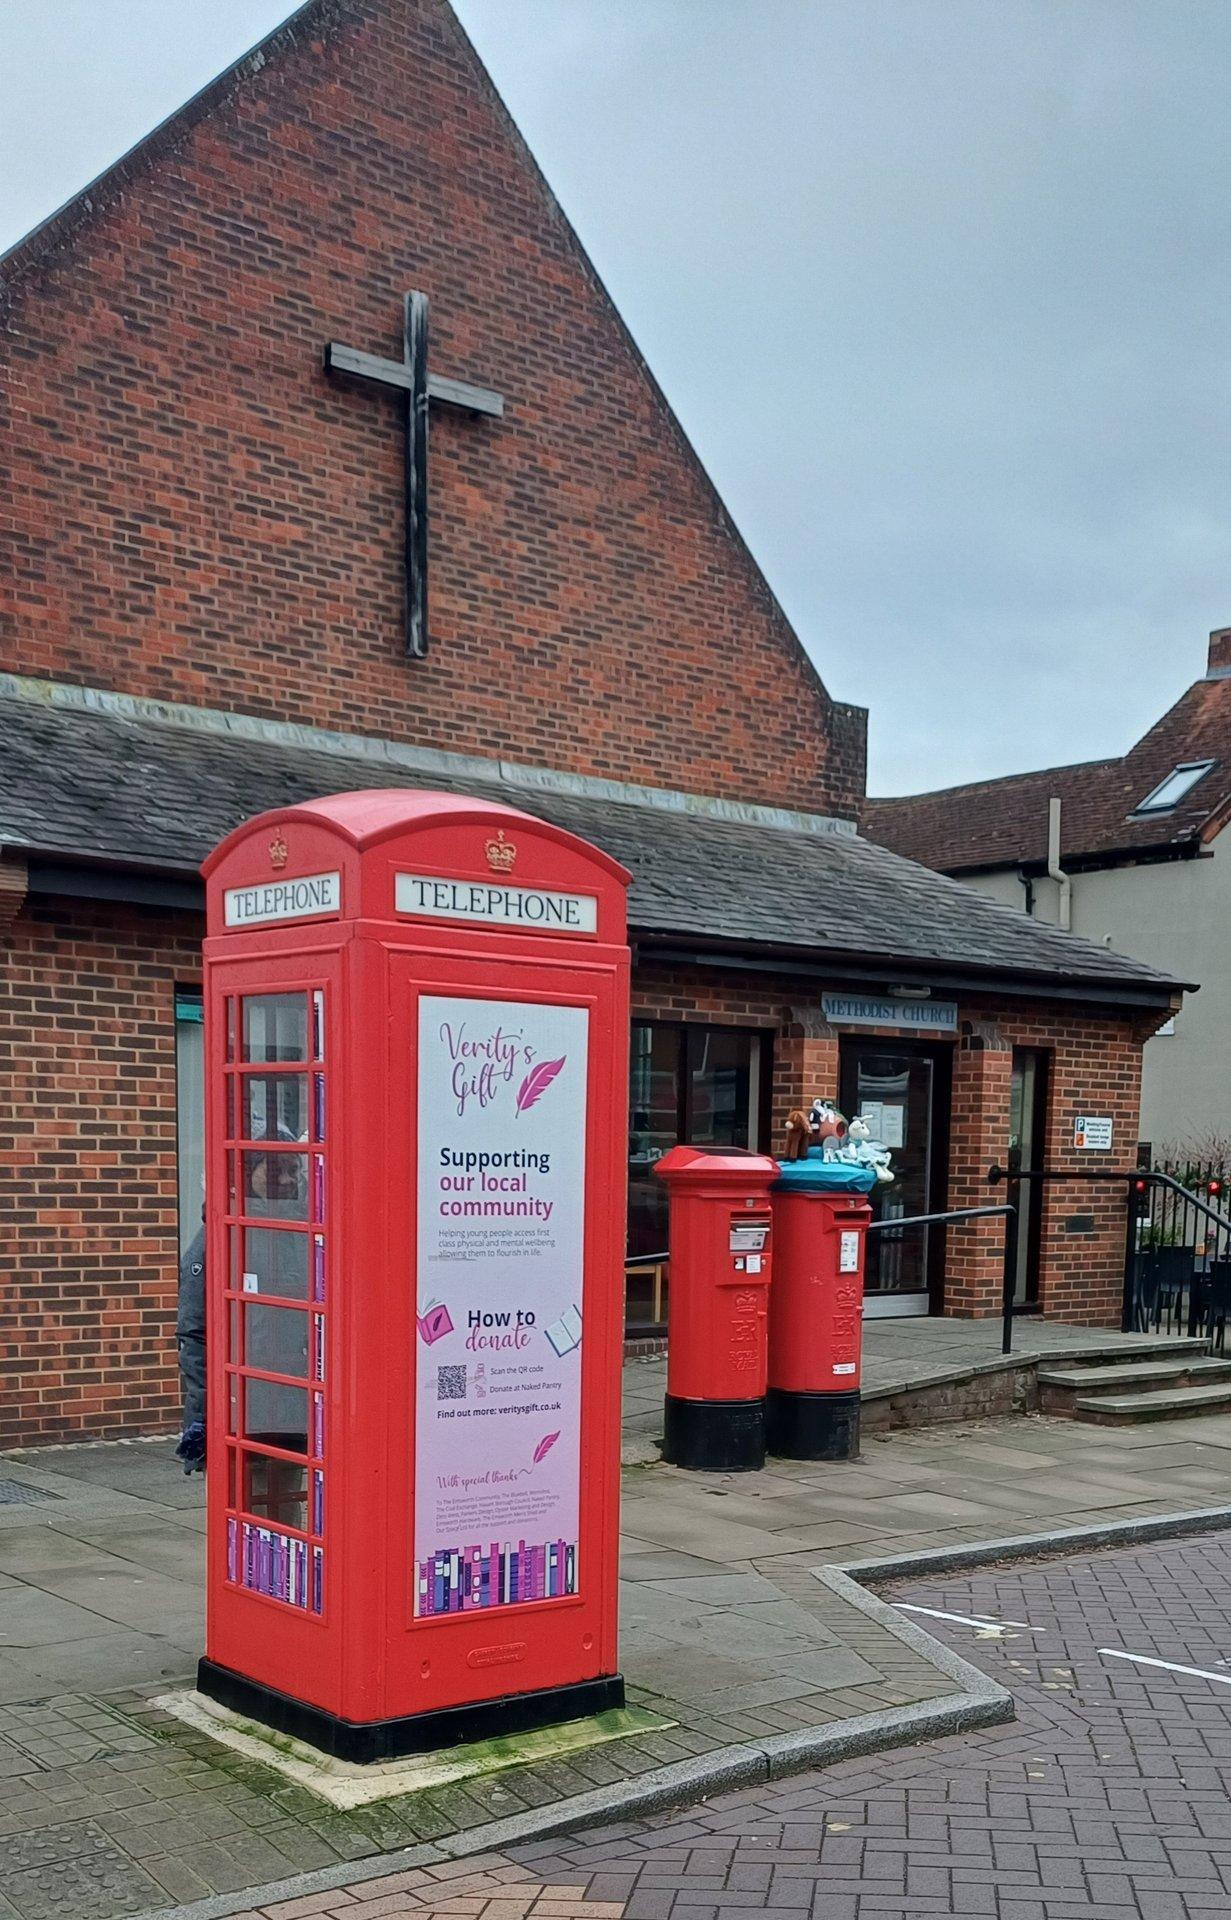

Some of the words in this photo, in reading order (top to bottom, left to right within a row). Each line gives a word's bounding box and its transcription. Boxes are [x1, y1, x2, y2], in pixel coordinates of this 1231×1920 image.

[234, 879, 332, 918] TELEPHONE
[412, 880, 581, 924] TELEPHONE
[824, 999, 897, 1019] METHODIST
[902, 1005, 955, 1024] CHURCH
[440, 1022, 537, 1081] Verity's
[452, 1062, 513, 1116] Gift
[440, 1147, 550, 1173] Supporting
[440, 1176, 475, 1191] our
[481, 1172, 527, 1192] local
[440, 1197, 553, 1221] community
[438, 1229, 466, 1238] Helping
[466, 1231, 488, 1239] young
[489, 1229, 513, 1238] people
[514, 1229, 536, 1237] access
[536, 1228, 550, 1237] first
[438, 1240, 456, 1248] class
[457, 1239, 485, 1250] physical
[486, 1239, 499, 1247] and
[500, 1238, 524, 1247] mental
[525, 1238, 556, 1248] wellbeing
[467, 1249, 487, 1257] them
[488, 1249, 495, 1257] to
[496, 1248, 521, 1257] flourish
[522, 1248, 530, 1257] in
[468, 1310, 511, 1328] How
[516, 1309, 536, 1326] to
[466, 1322, 537, 1351] donate
[490, 1368, 506, 1376] Scan
[518, 1366, 528, 1374] QR
[529, 1365, 544, 1373] code
[490, 1385, 512, 1393] Donate
[521, 1382, 541, 1392] Naked
[542, 1381, 562, 1392] Pantry
[437, 1409, 455, 1419] Find
[457, 1408, 471, 1418] out
[473, 1407, 497, 1417] more:
[498, 1402, 561, 1415] veritysgift.co.uk
[437, 1474, 461, 1488] With
[461, 1471, 490, 1492] special
[492, 1468, 518, 1484] thanks
